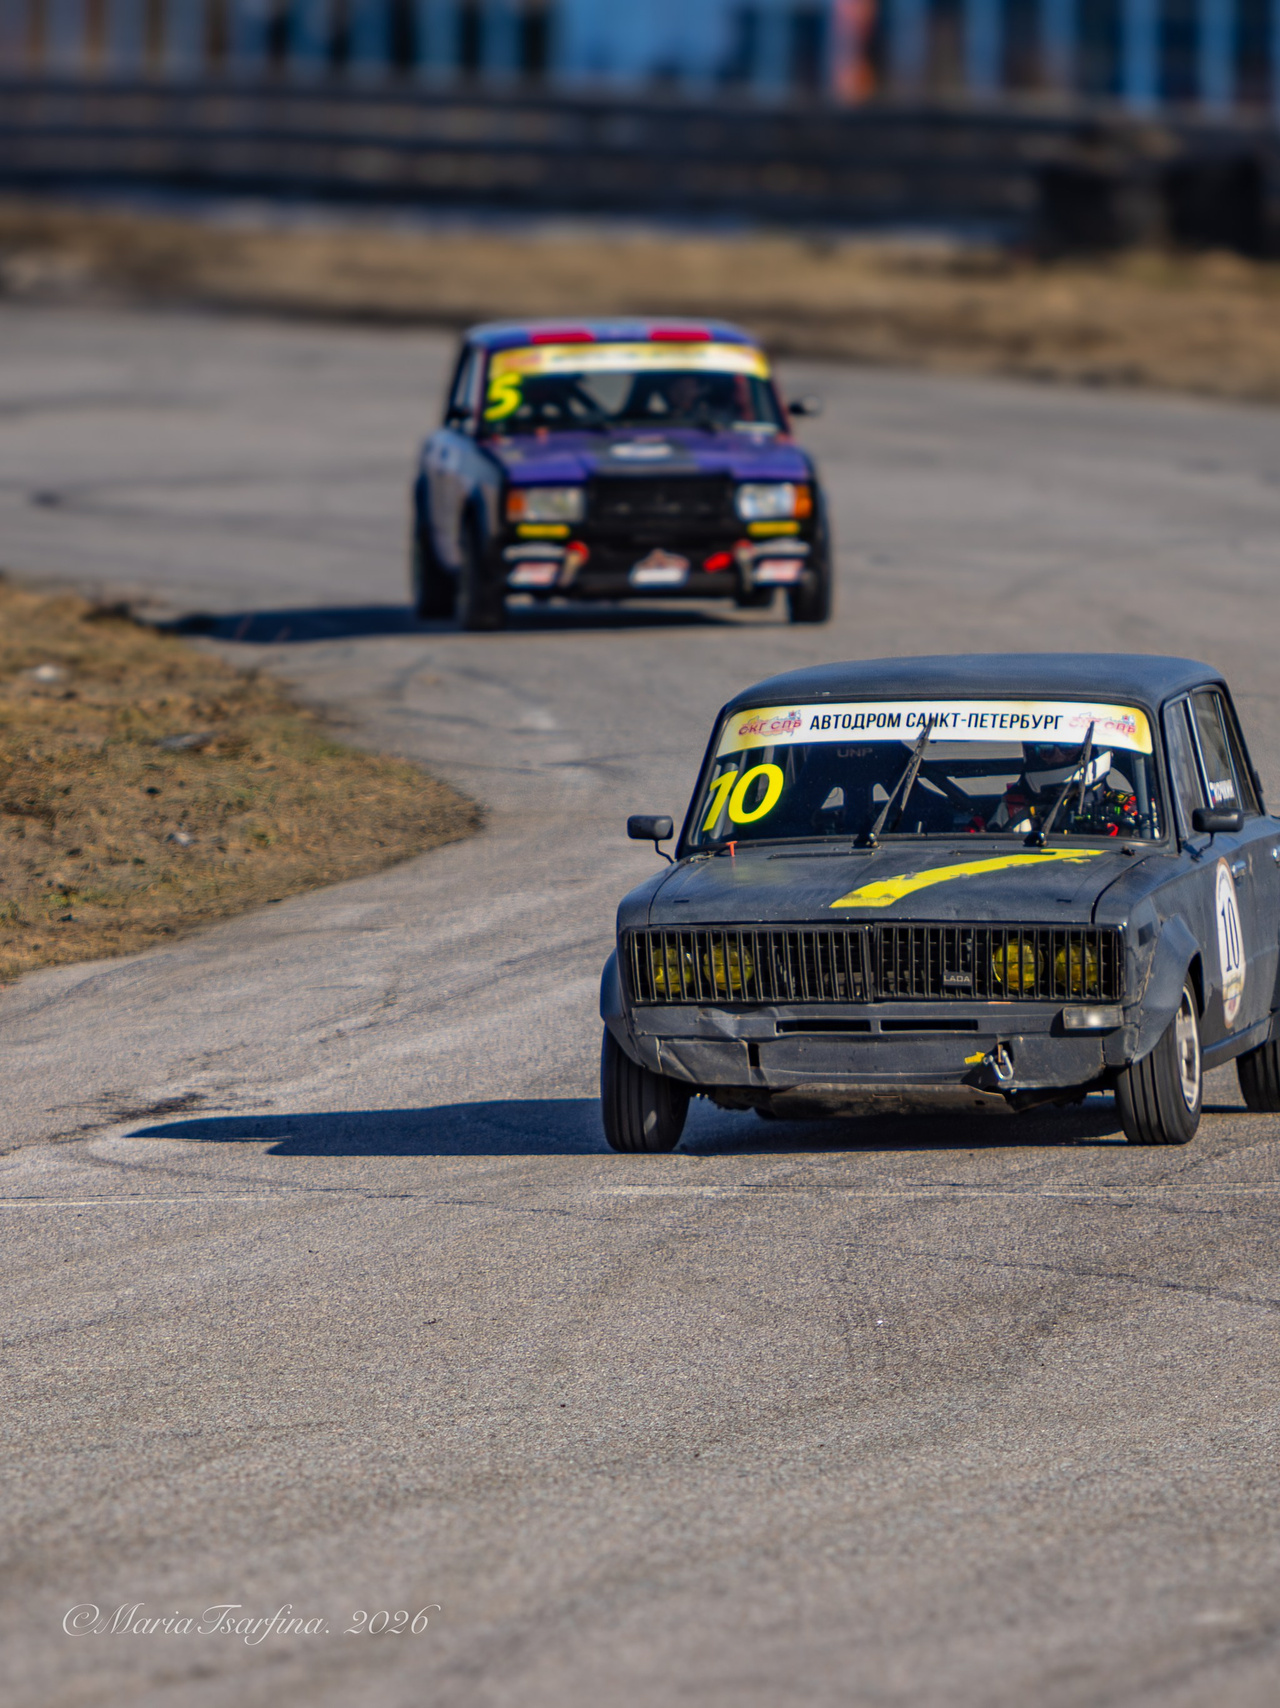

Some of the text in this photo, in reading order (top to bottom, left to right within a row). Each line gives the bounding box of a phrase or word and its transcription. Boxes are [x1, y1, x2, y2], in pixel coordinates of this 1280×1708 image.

[484, 372, 523, 420] 5
[809, 712, 900, 730] АВТОДРОМ
[905, 712, 1064, 730] САНКТ-ПЕТЕРБУРГ
[702, 763, 784, 832] 10
[1221, 897, 1240, 972] 10
[943, 975, 971, 983] LADA
